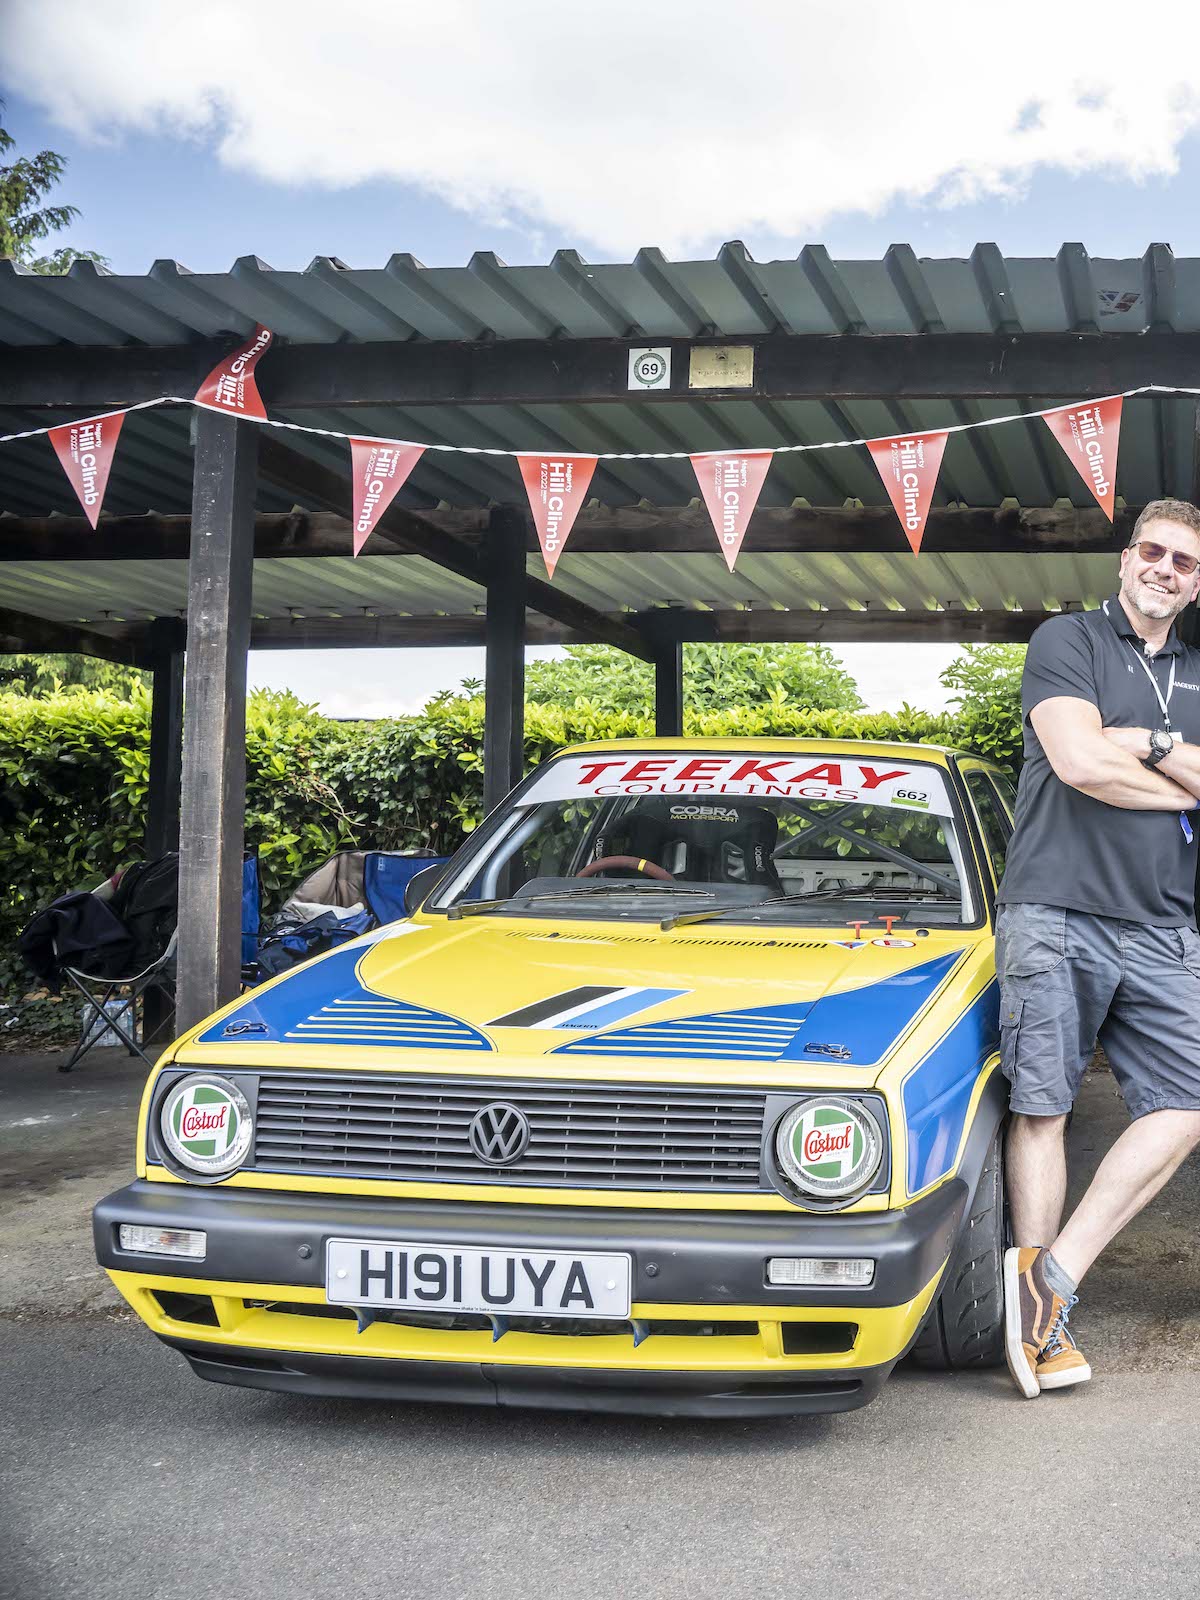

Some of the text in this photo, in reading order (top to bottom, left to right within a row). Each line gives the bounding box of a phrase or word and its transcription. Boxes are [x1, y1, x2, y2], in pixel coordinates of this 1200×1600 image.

[222, 330, 270, 406] Hill Climb
[641, 363, 659, 375] 69
[1094, 407, 1104, 434] Hagerty
[80, 425, 100, 506] Hill Climb
[388, 450, 400, 478] Hagerty
[1077, 409, 1110, 496] Hill Climb
[357, 448, 393, 532] Hill Climb
[565, 463, 573, 493] Hagerty
[900, 441, 922, 530] Hill Climb
[545, 462, 564, 552] Hill Climb
[723, 460, 739, 545] Hill Climb
[577, 759, 911, 789] TEEKAY
[594, 783, 859, 800] COUPLINGS
[896, 789, 928, 802] 662
[669, 805, 739, 818] COBRA
[670, 814, 739, 823] MOTORSPORT
[182, 1106, 227, 1138] Castrol
[804, 1125, 852, 1162] Castrol
[481, 1256, 594, 1308] UYA
